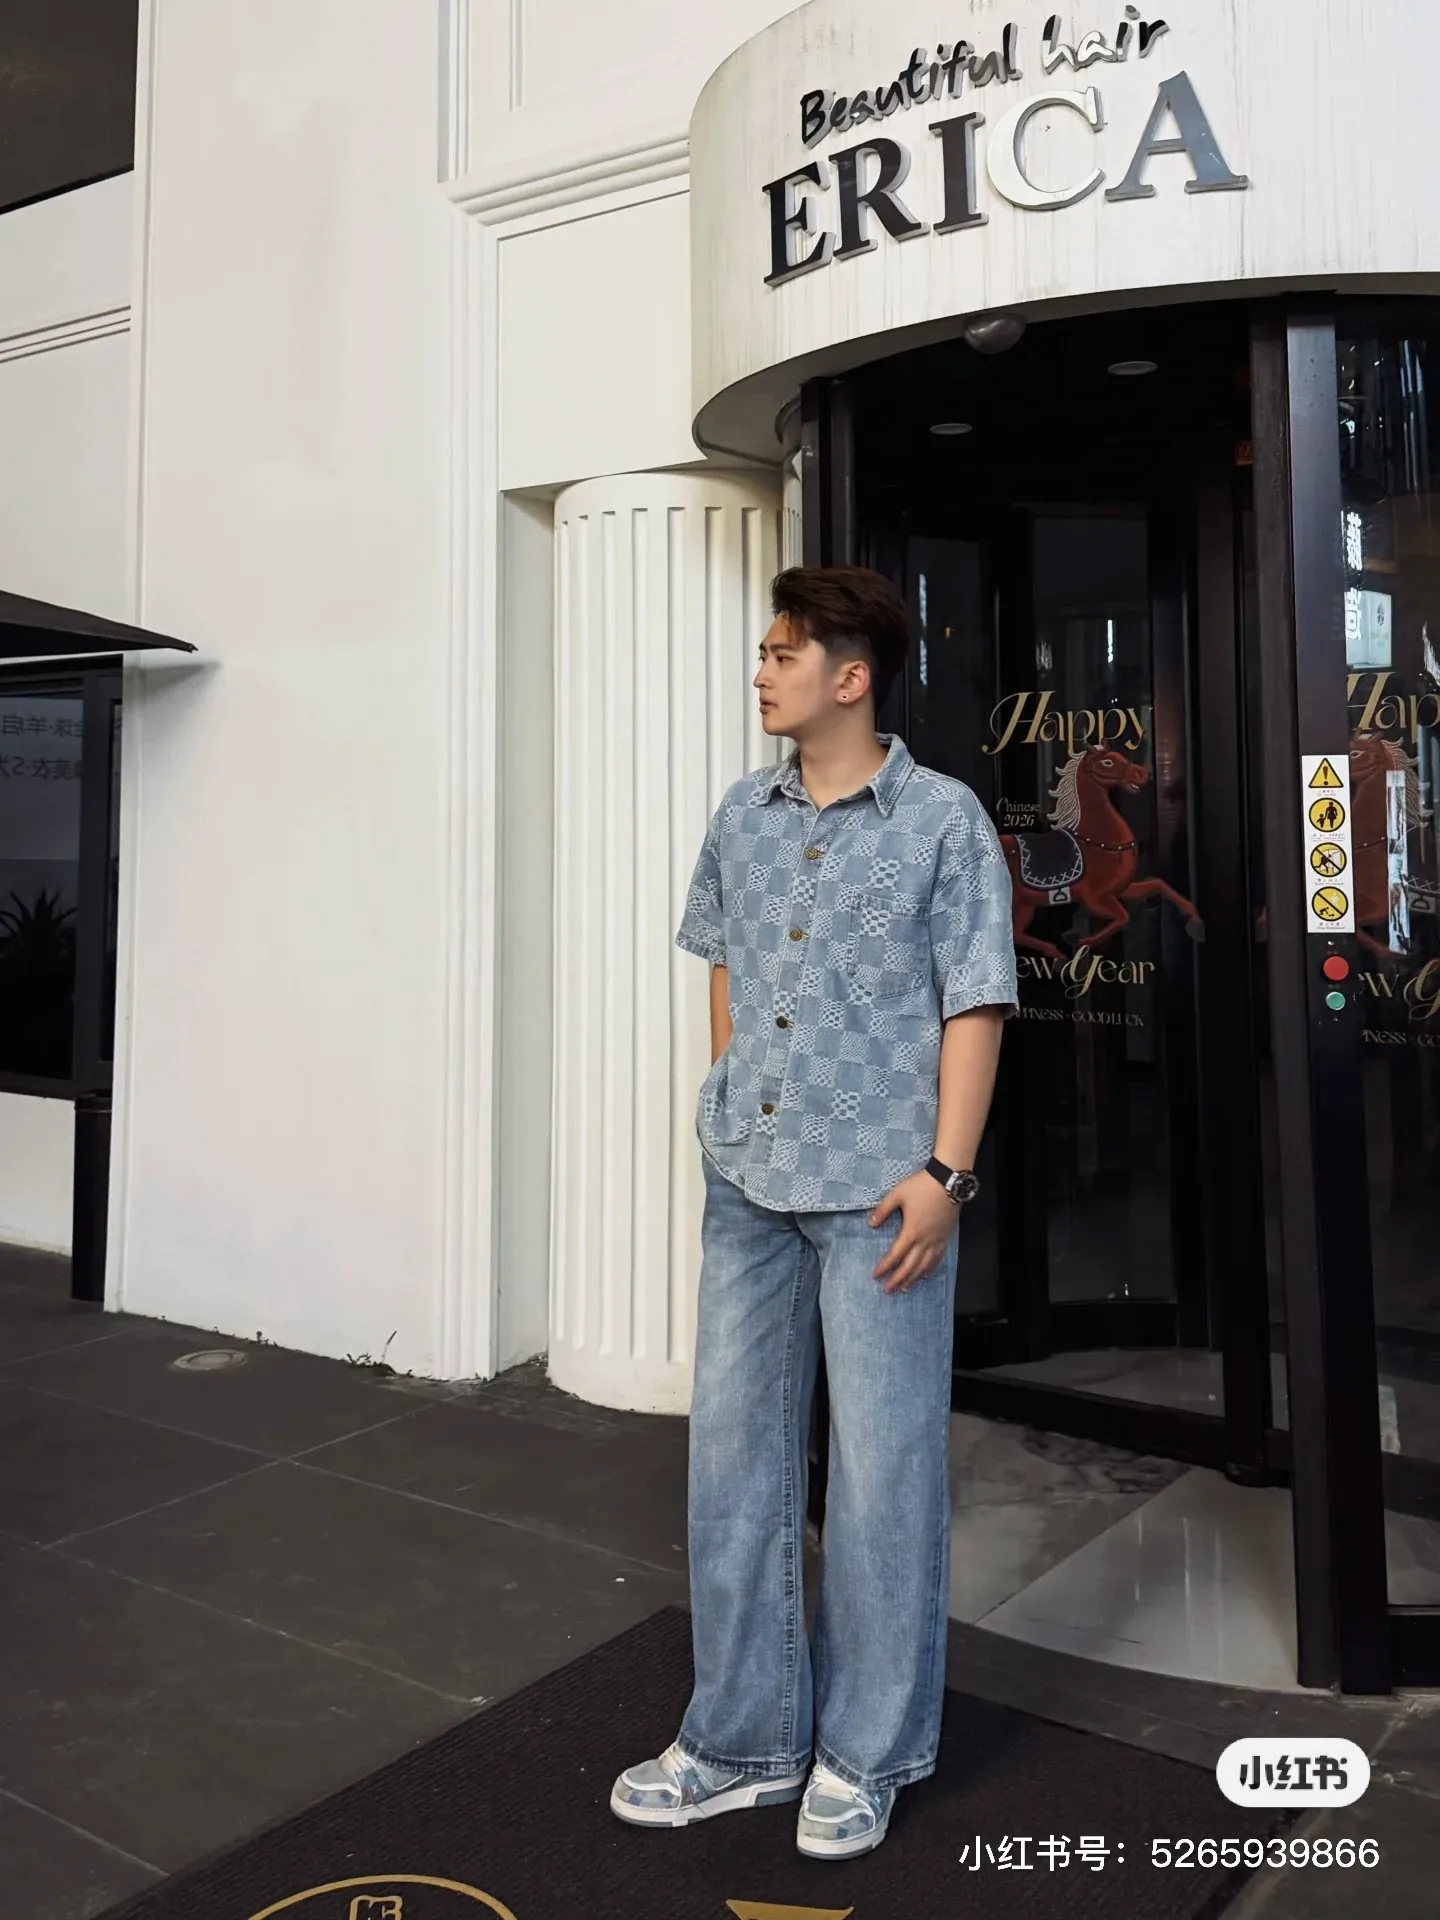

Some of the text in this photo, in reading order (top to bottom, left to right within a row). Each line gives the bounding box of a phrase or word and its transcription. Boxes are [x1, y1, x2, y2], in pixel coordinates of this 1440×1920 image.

[801, 5, 1170, 148] Beautiful hair
[762, 70, 1249, 288] ERICA
[981, 690, 1153, 758] Happy
[1003, 814, 1036, 827] 2026
[1016, 955, 1058, 980] ew
